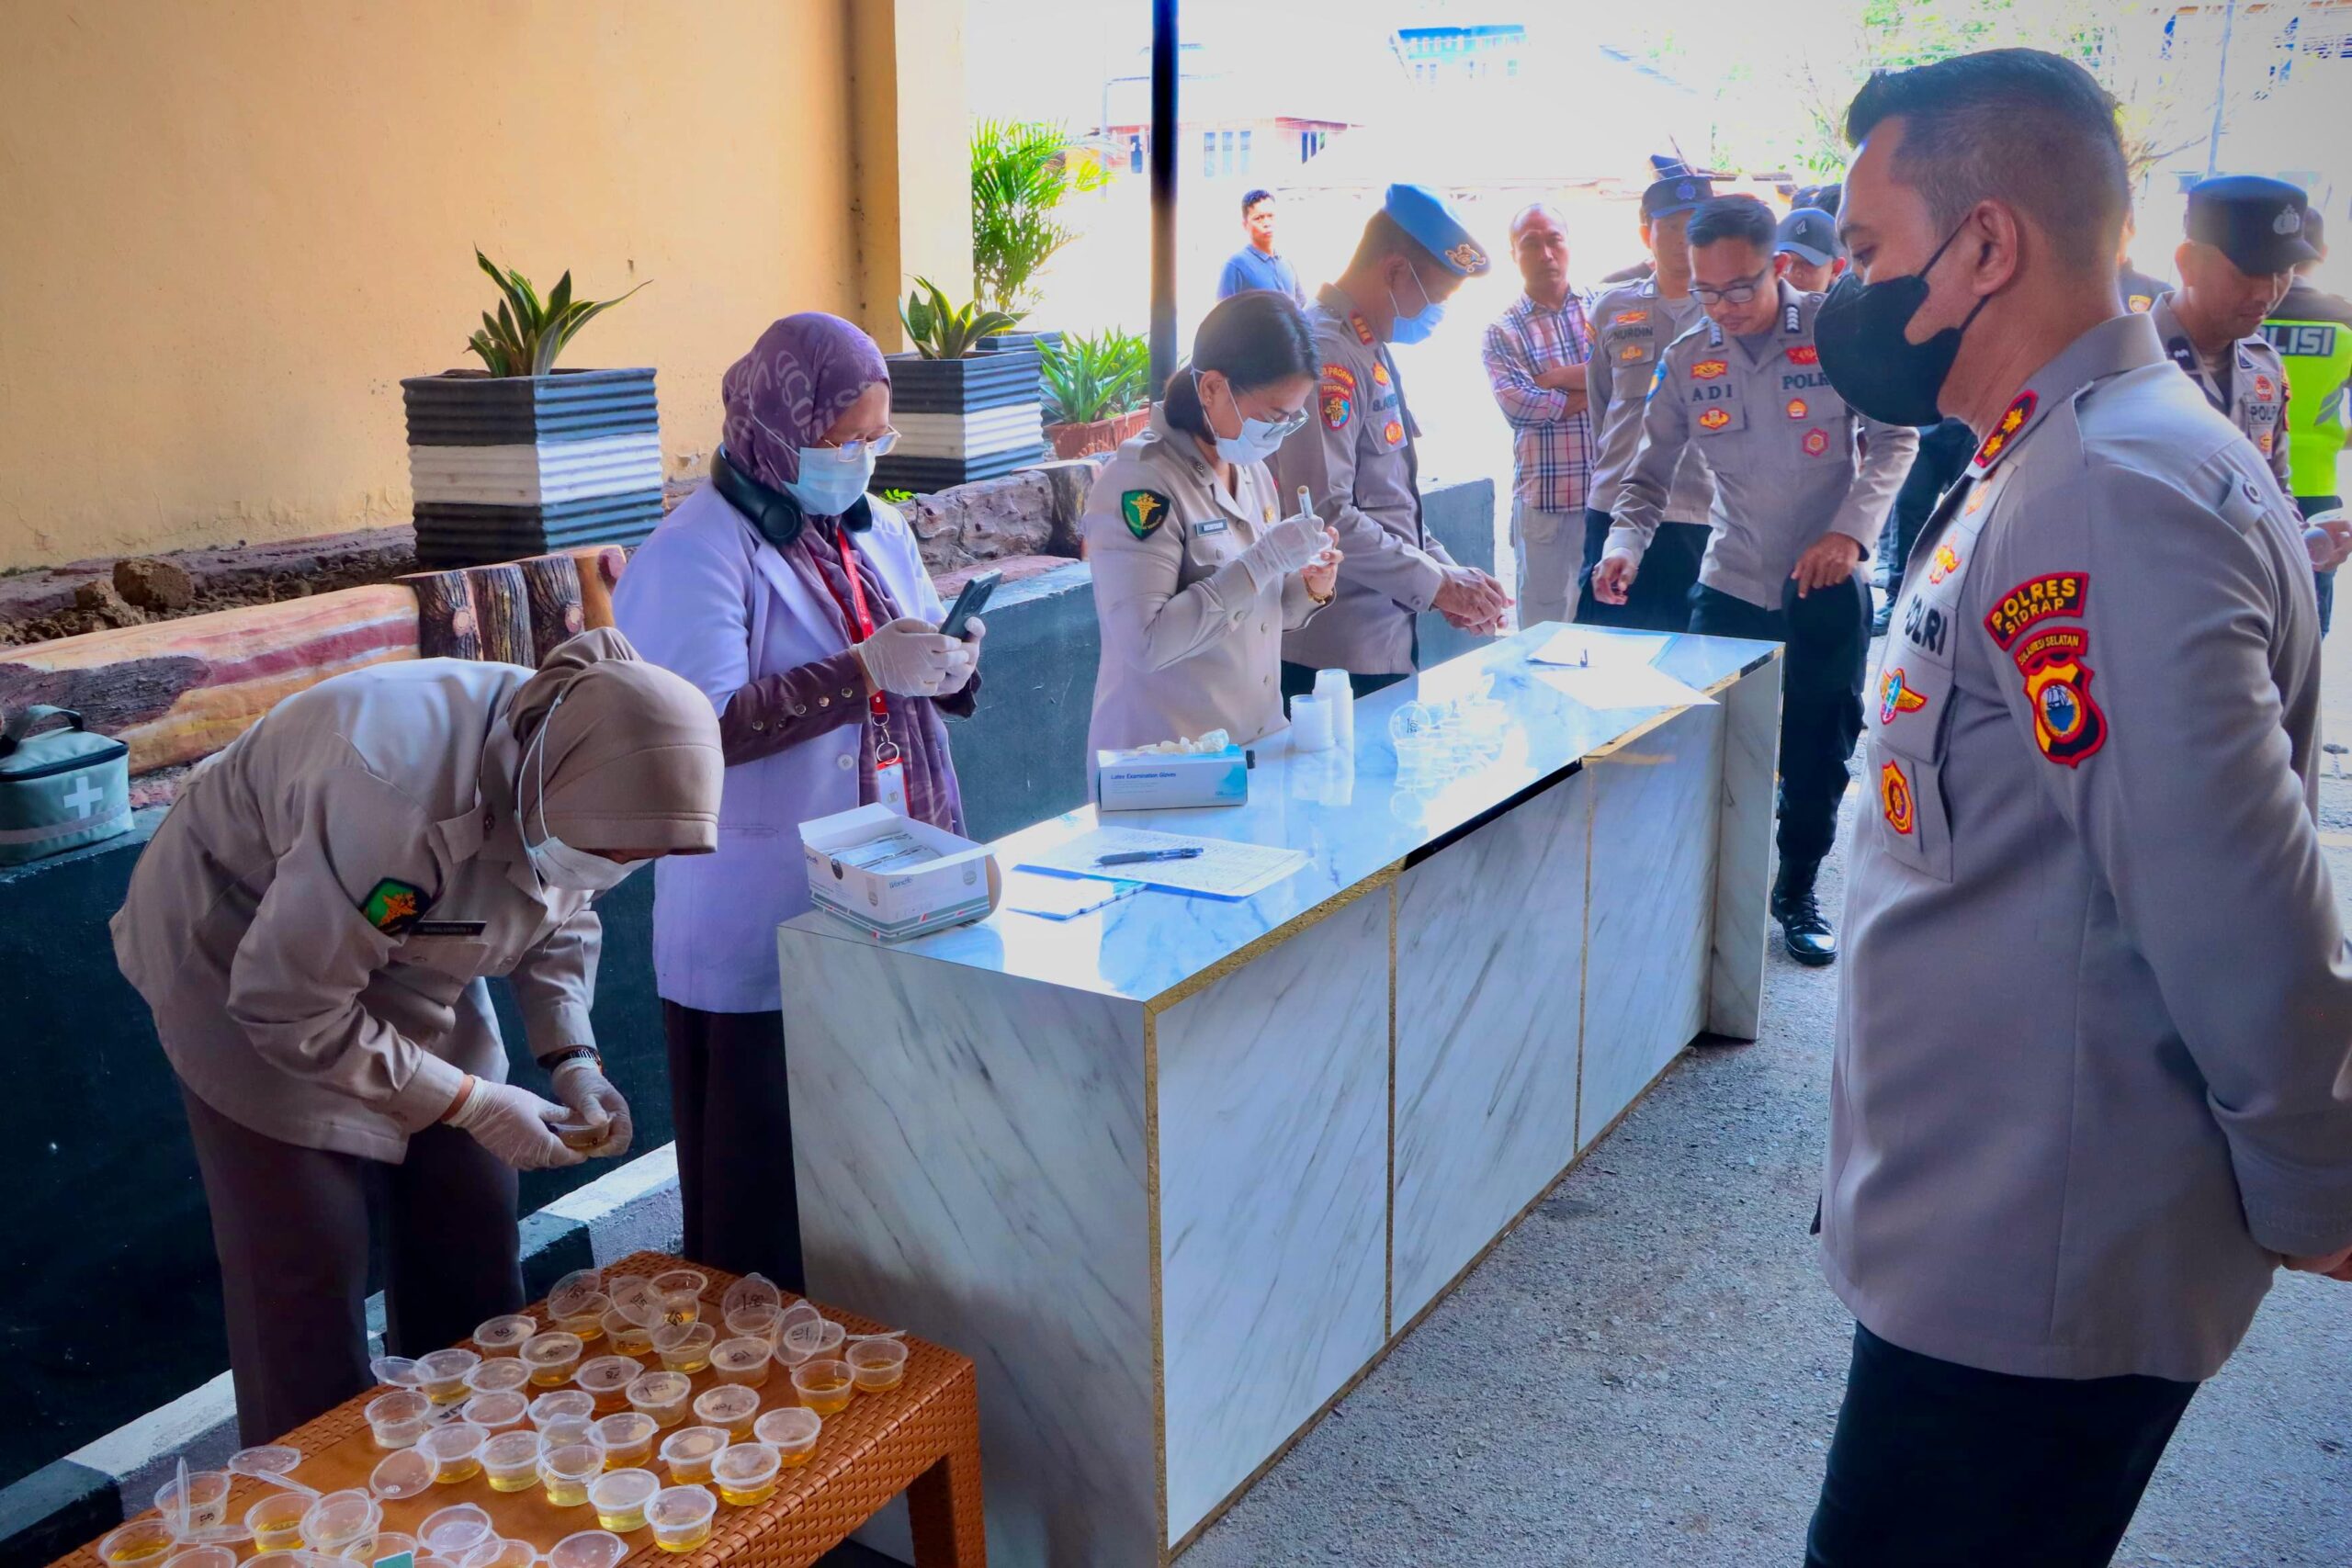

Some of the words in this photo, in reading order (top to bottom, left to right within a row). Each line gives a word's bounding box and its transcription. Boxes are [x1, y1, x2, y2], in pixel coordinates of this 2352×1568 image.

[2264, 327, 2333, 355] LISI
[1782, 372, 1830, 389] POLR
[1691, 384, 1733, 401] ADI
[1991, 578, 2076, 631] POLRES
[2005, 597, 2064, 634] SIDRAP
[2045, 634, 2079, 647] SELATAN
